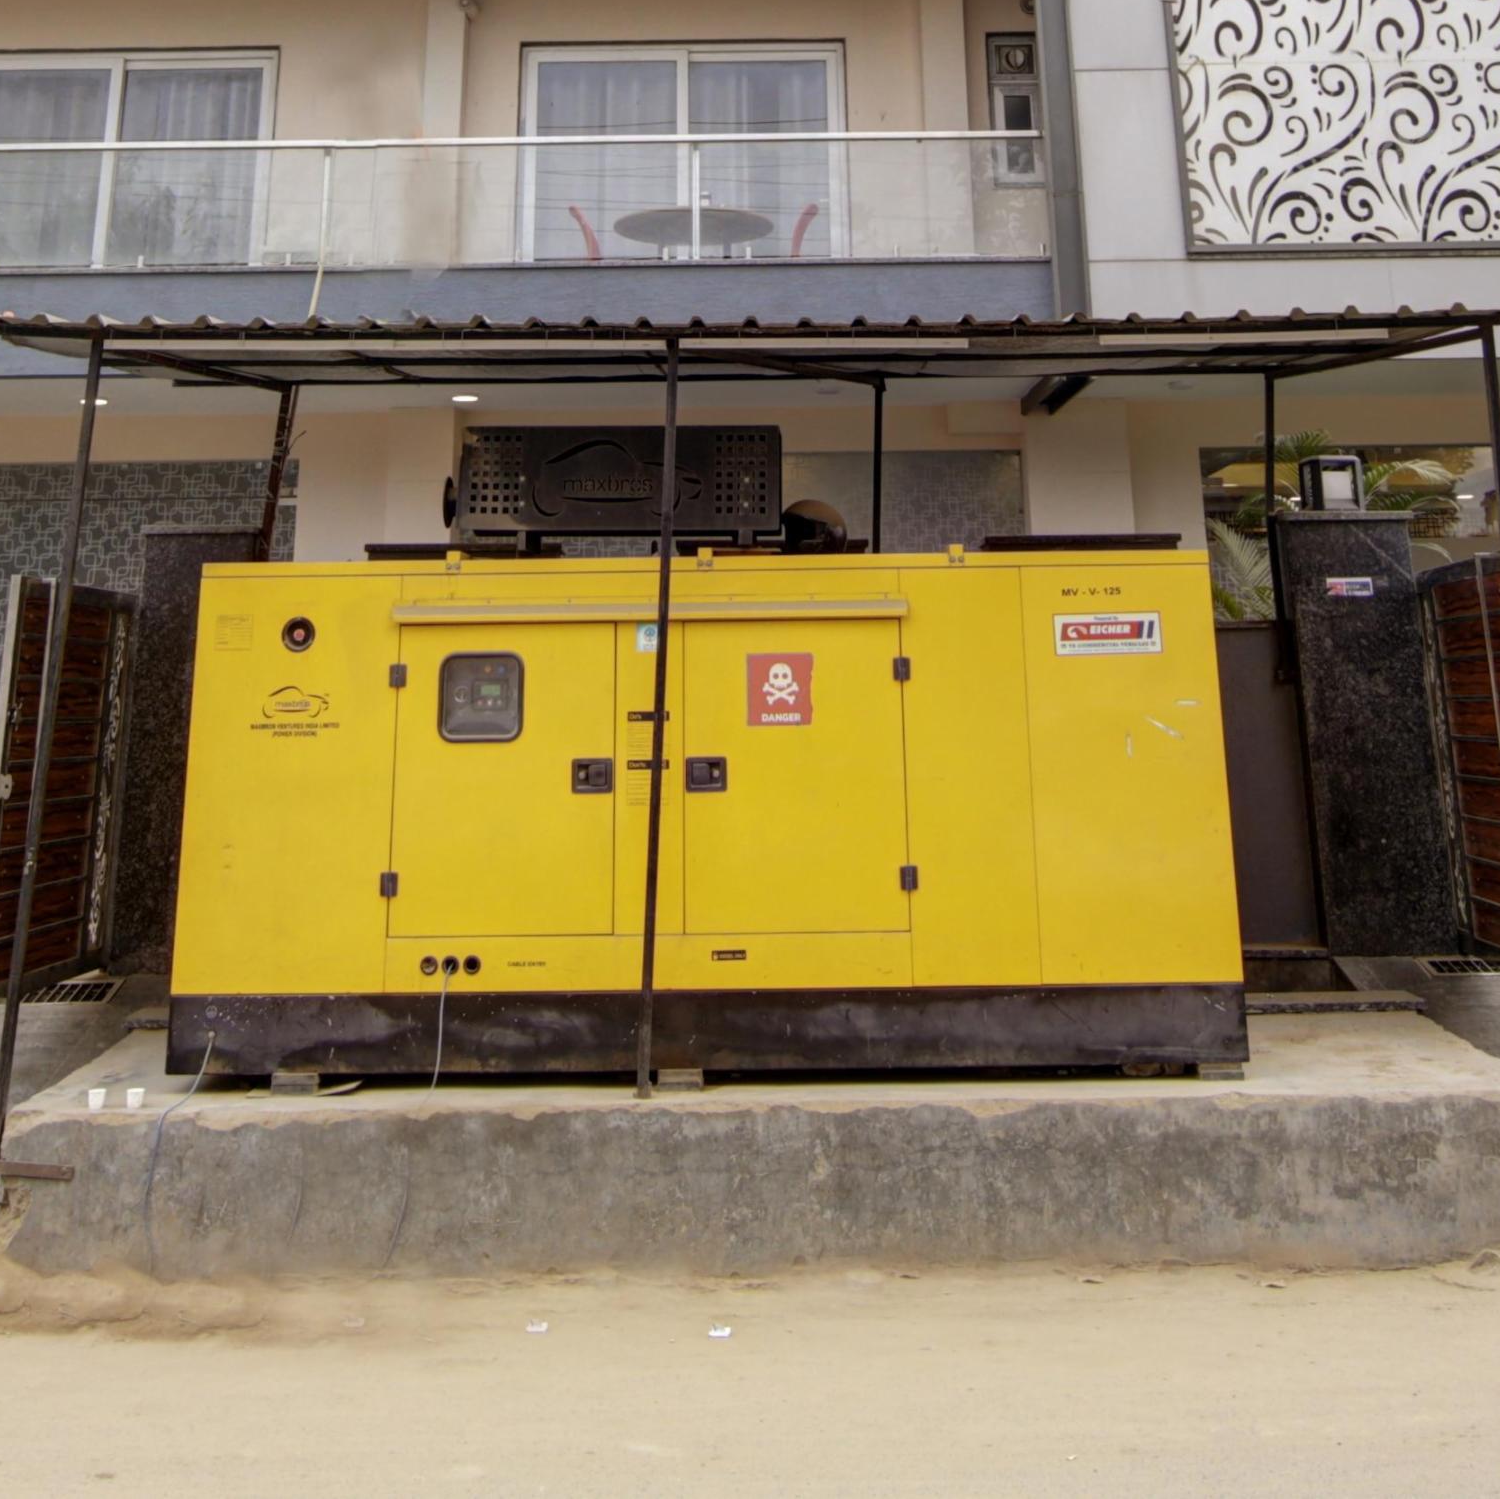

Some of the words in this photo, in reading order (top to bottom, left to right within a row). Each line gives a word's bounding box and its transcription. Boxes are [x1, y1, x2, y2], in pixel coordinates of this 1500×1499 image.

[1104, 587, 1121, 595] 125
[1089, 624, 1132, 635] EICHER
[761, 712, 802, 723] DANGER
